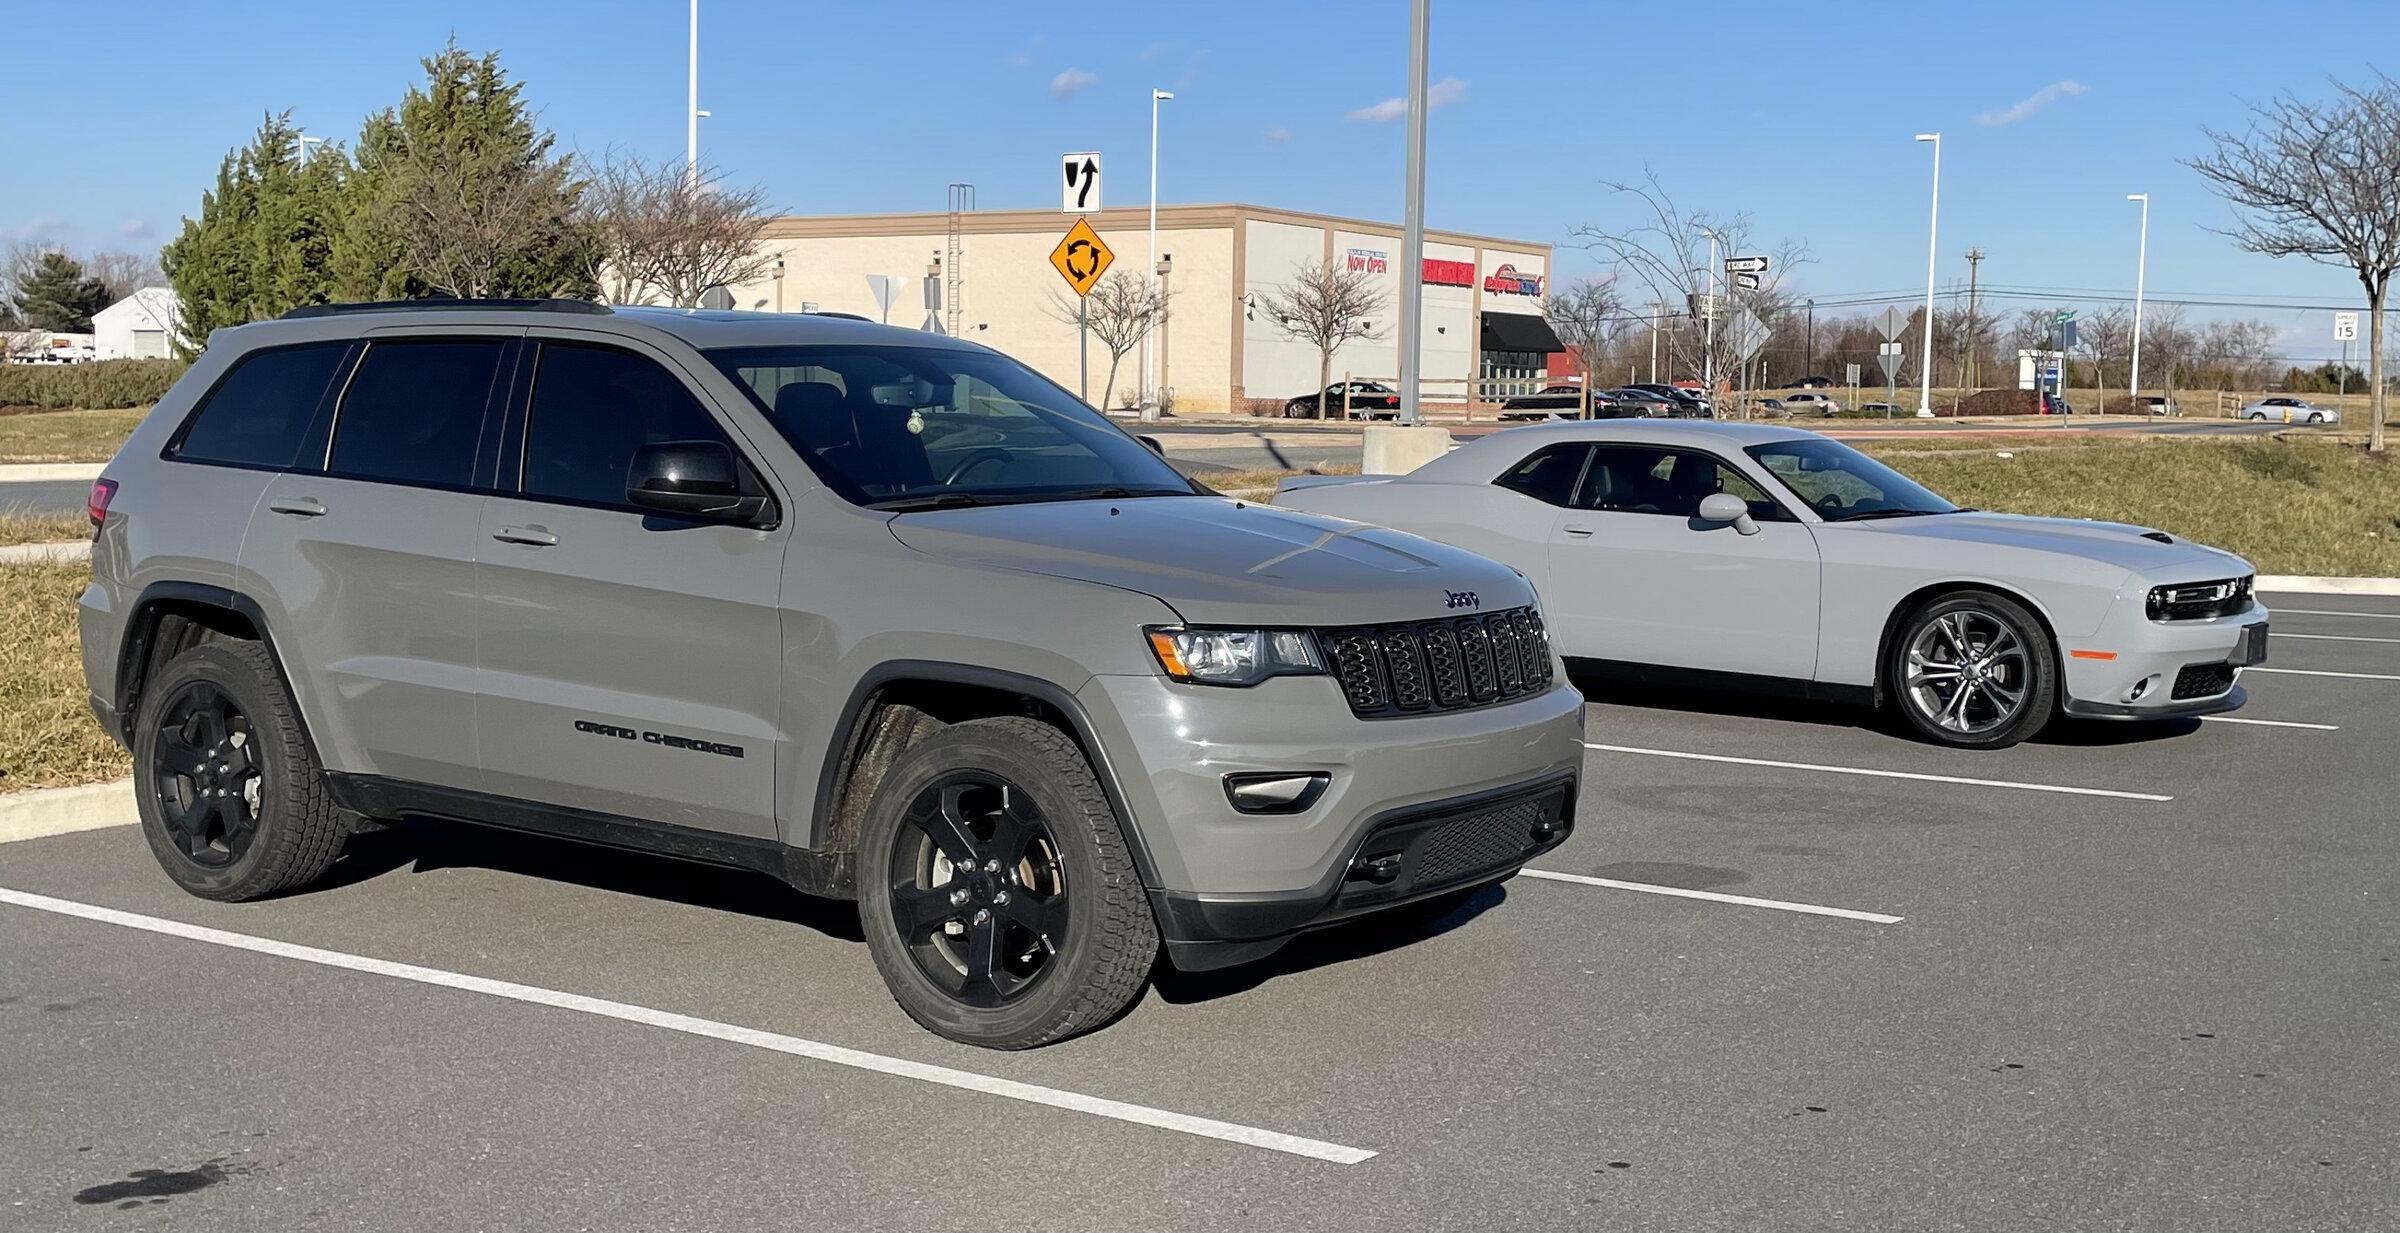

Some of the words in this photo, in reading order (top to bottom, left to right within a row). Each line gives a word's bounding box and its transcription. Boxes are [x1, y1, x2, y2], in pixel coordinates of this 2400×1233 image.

[1347, 254, 1364, 272] NOW
[1367, 256, 1387, 273] OPEN
[2338, 326, 2353, 337] 15
[1444, 589, 1480, 610] Jeep
[574, 720, 637, 740] GRAND
[642, 731, 745, 759] CHEROKEE
